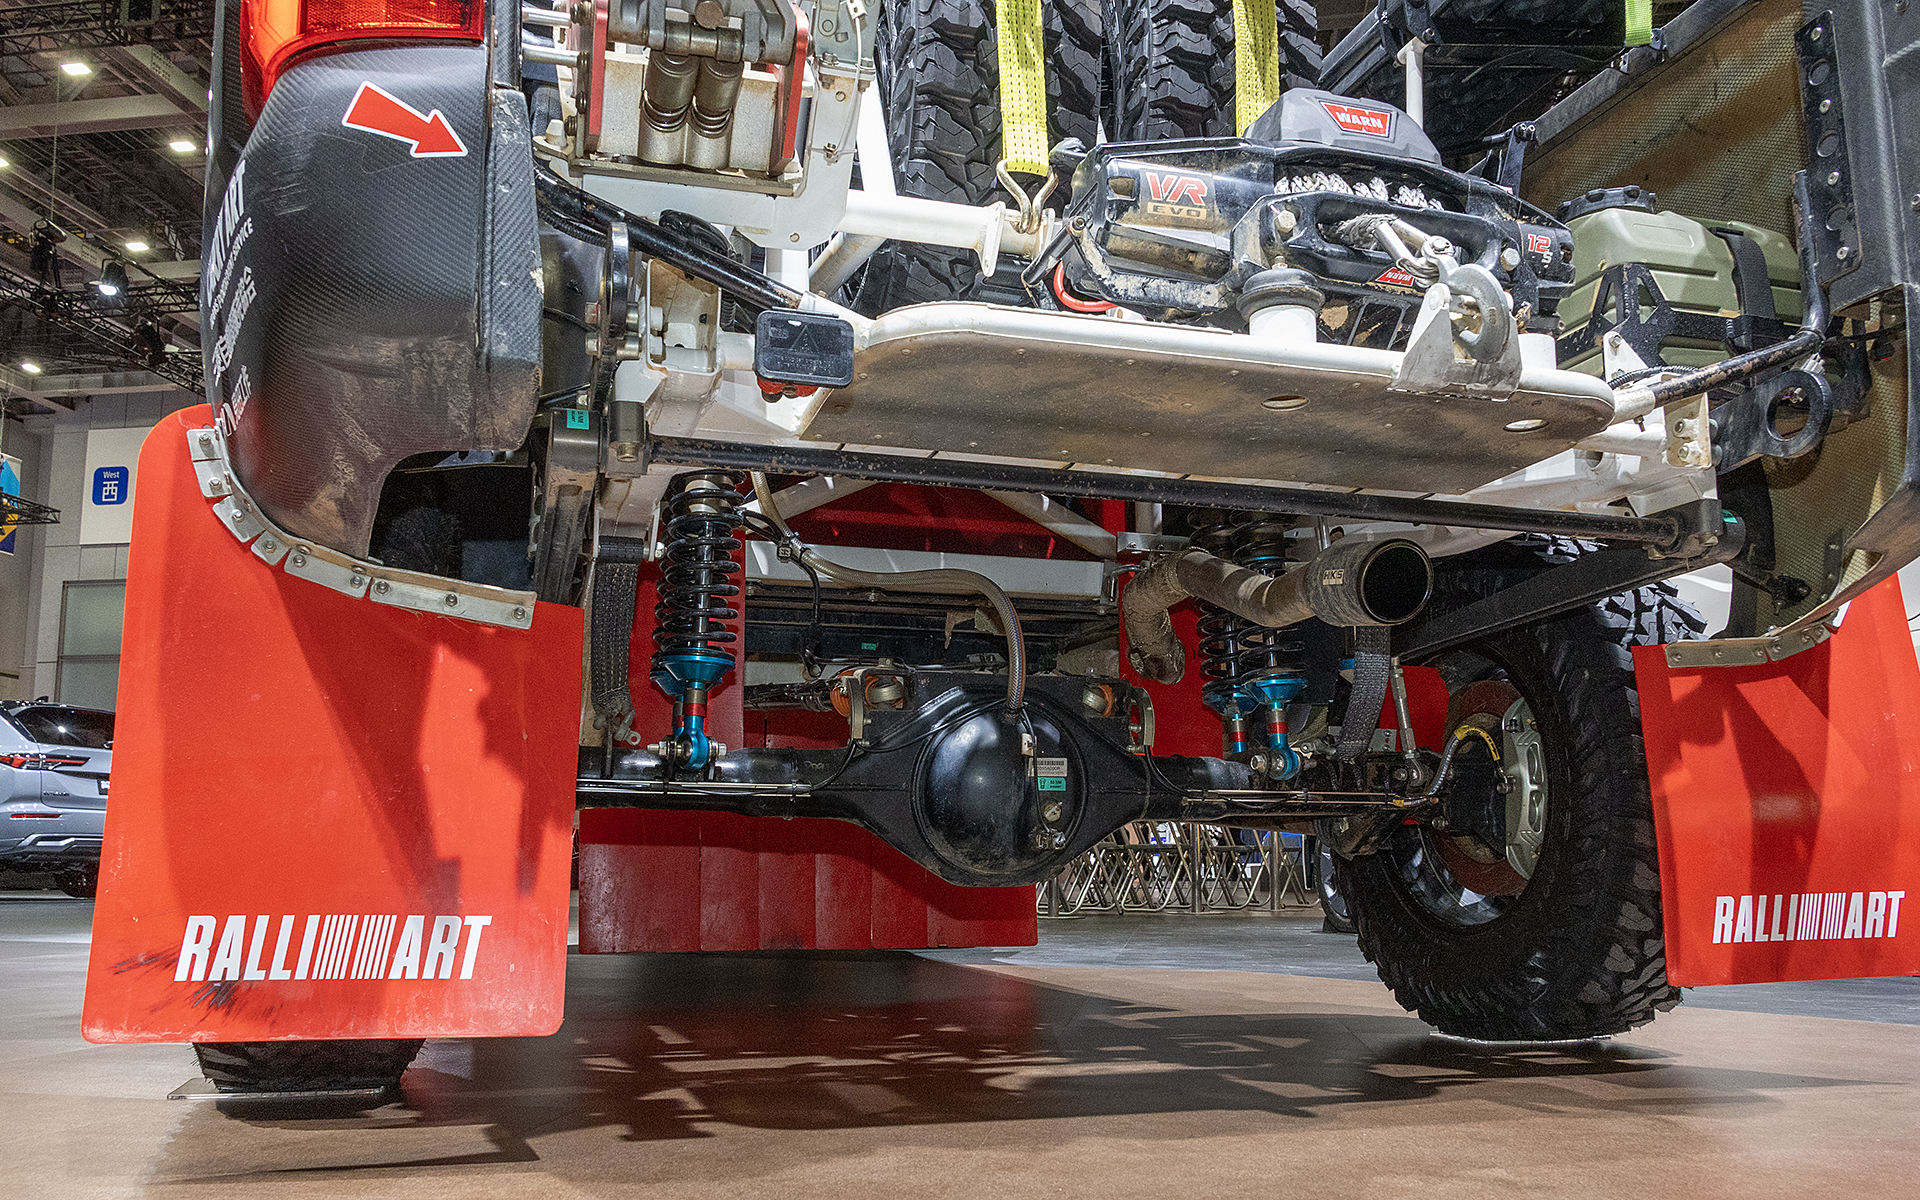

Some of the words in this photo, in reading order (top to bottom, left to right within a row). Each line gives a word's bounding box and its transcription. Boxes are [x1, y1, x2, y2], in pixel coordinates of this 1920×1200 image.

[1335, 111, 1384, 129] WARN
[1145, 172, 1208, 206] VR
[1152, 204, 1201, 218] EVO
[1528, 233, 1552, 254] 12
[1385, 271, 1412, 282] WARN
[102, 481, 118, 501] 西
[1323, 569, 1343, 581] HKS
[1712, 891, 1906, 944] RALLIART
[174, 915, 493, 982] RALLIART
